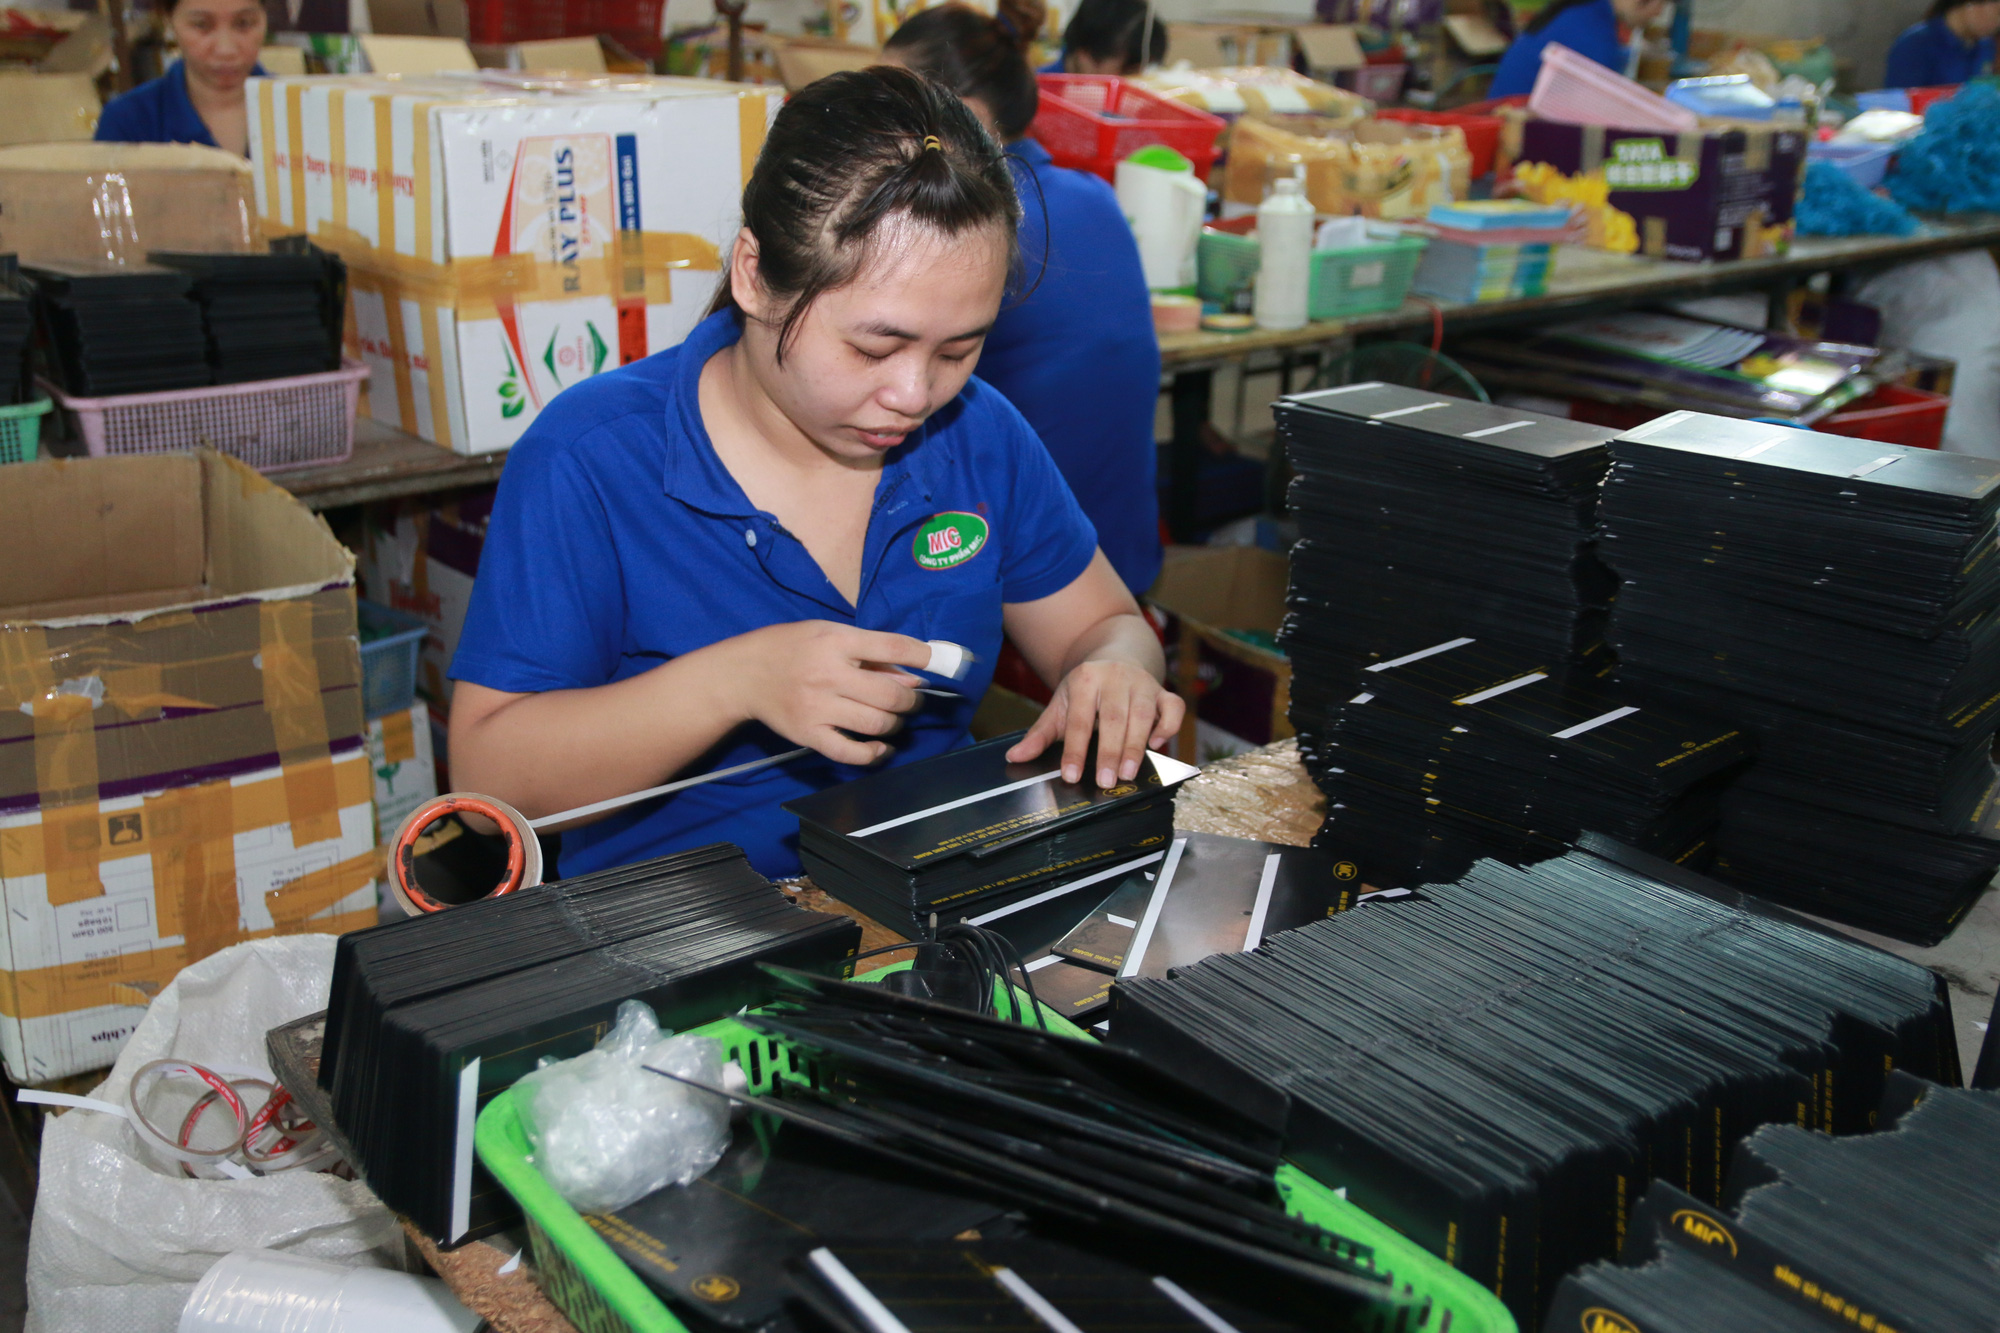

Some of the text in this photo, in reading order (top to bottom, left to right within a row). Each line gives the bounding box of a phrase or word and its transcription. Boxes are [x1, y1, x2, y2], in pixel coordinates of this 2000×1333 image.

[556, 147, 581, 293] RAY PLUS
[919, 554, 937, 566] CÔNG
[938, 557, 948, 566] TY
[969, 535, 983, 551] MIC
[928, 526, 962, 555] MIC
[91, 1028, 126, 1043] chips
[207, 1074, 223, 1090] TAPE
